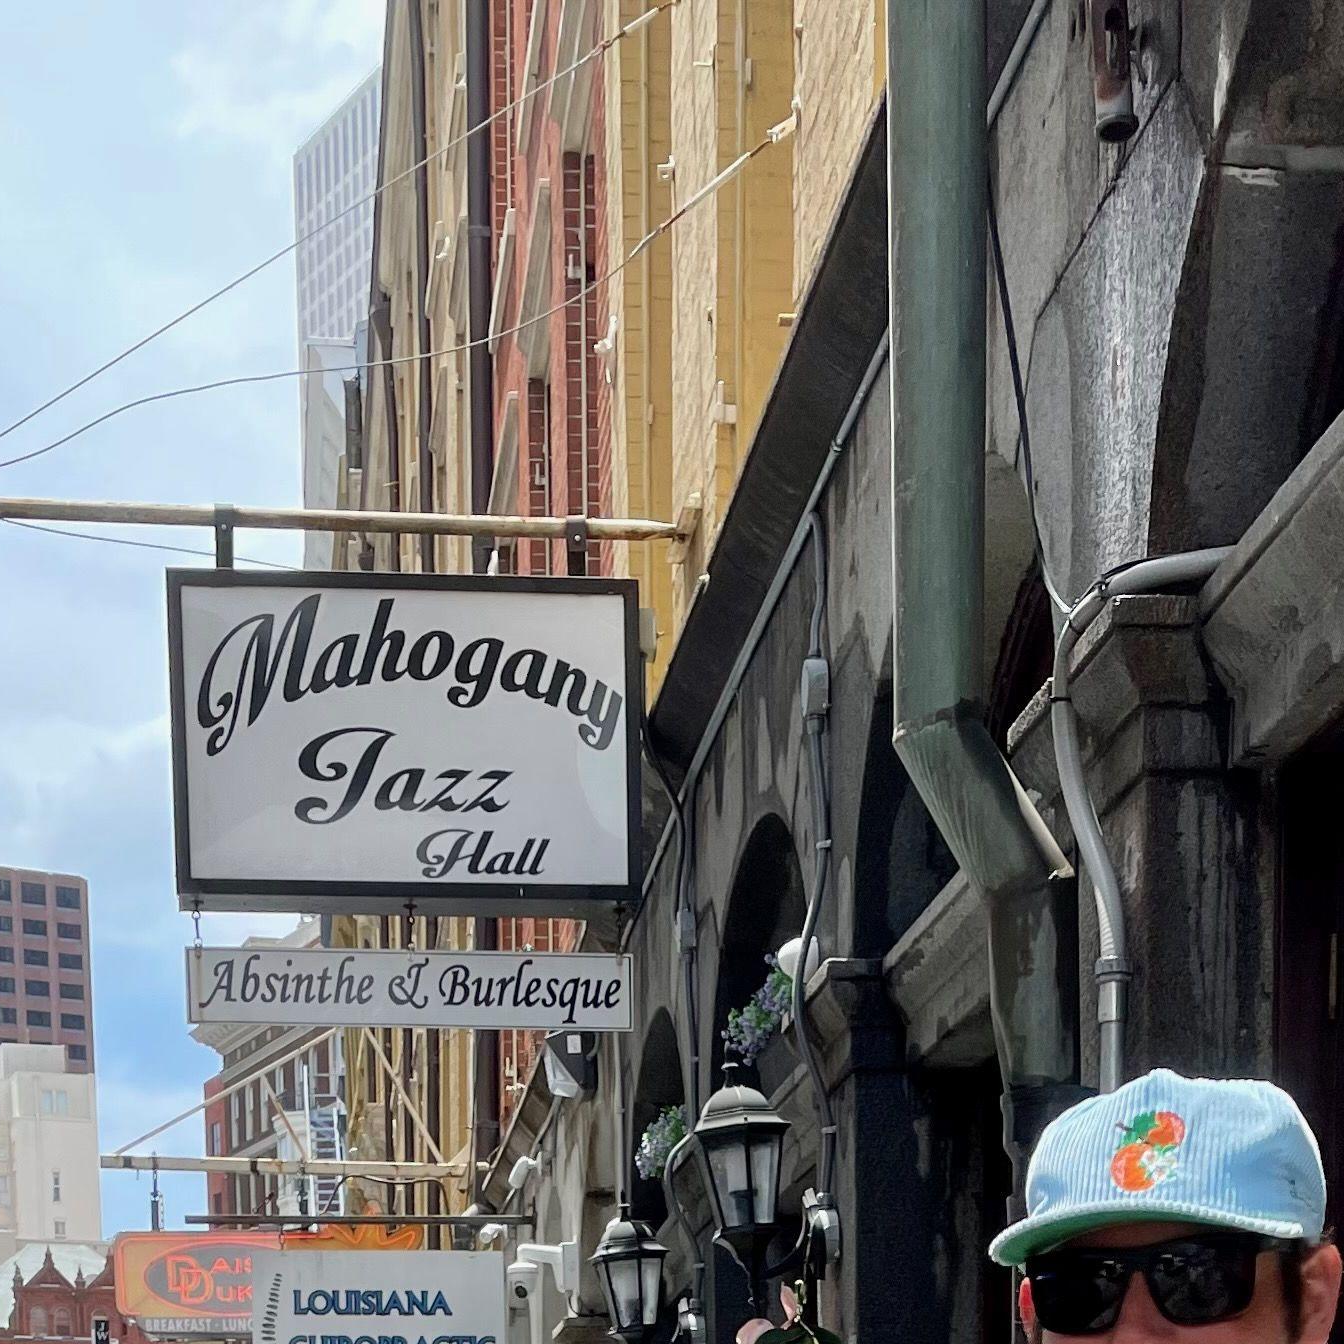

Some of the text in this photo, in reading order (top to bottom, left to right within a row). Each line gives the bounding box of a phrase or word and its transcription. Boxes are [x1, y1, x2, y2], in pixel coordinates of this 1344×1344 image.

[197, 593, 623, 756] Mahogany
[294, 727, 515, 824] Jazz
[416, 829, 550, 879] Hall
[199, 954, 622, 1024] Absinthe & Burlesque
[144, 1319, 211, 1332] BREAKFAST
[294, 1289, 452, 1316] LOUISIANA
